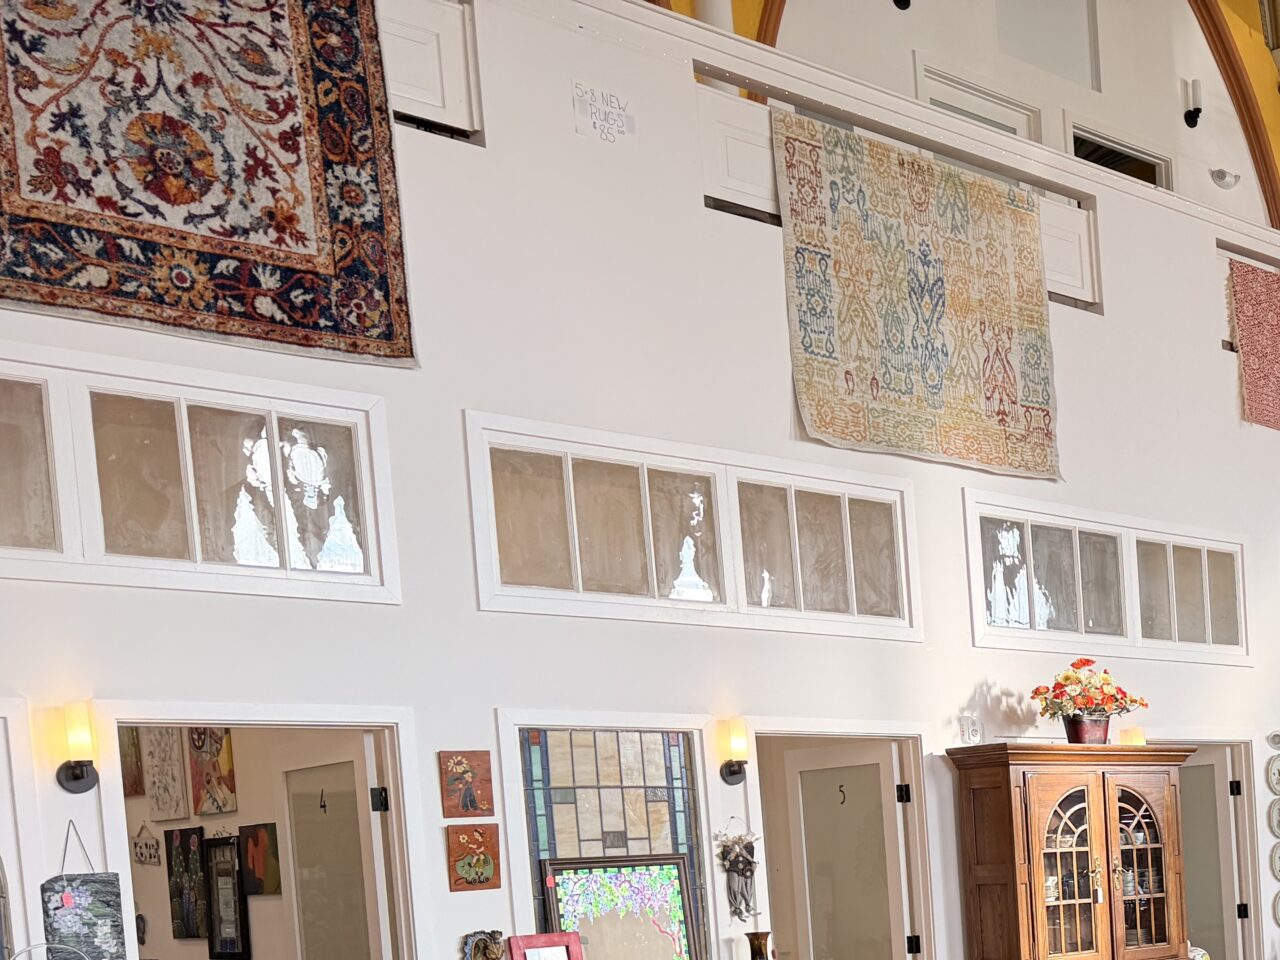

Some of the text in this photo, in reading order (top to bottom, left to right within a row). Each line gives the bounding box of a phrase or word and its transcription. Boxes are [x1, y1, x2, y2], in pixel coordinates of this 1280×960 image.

[601, 91, 628, 112] NEW
[589, 103, 625, 128] RUGS
[319, 787, 327, 815] 4
[838, 784, 846, 805] 5
